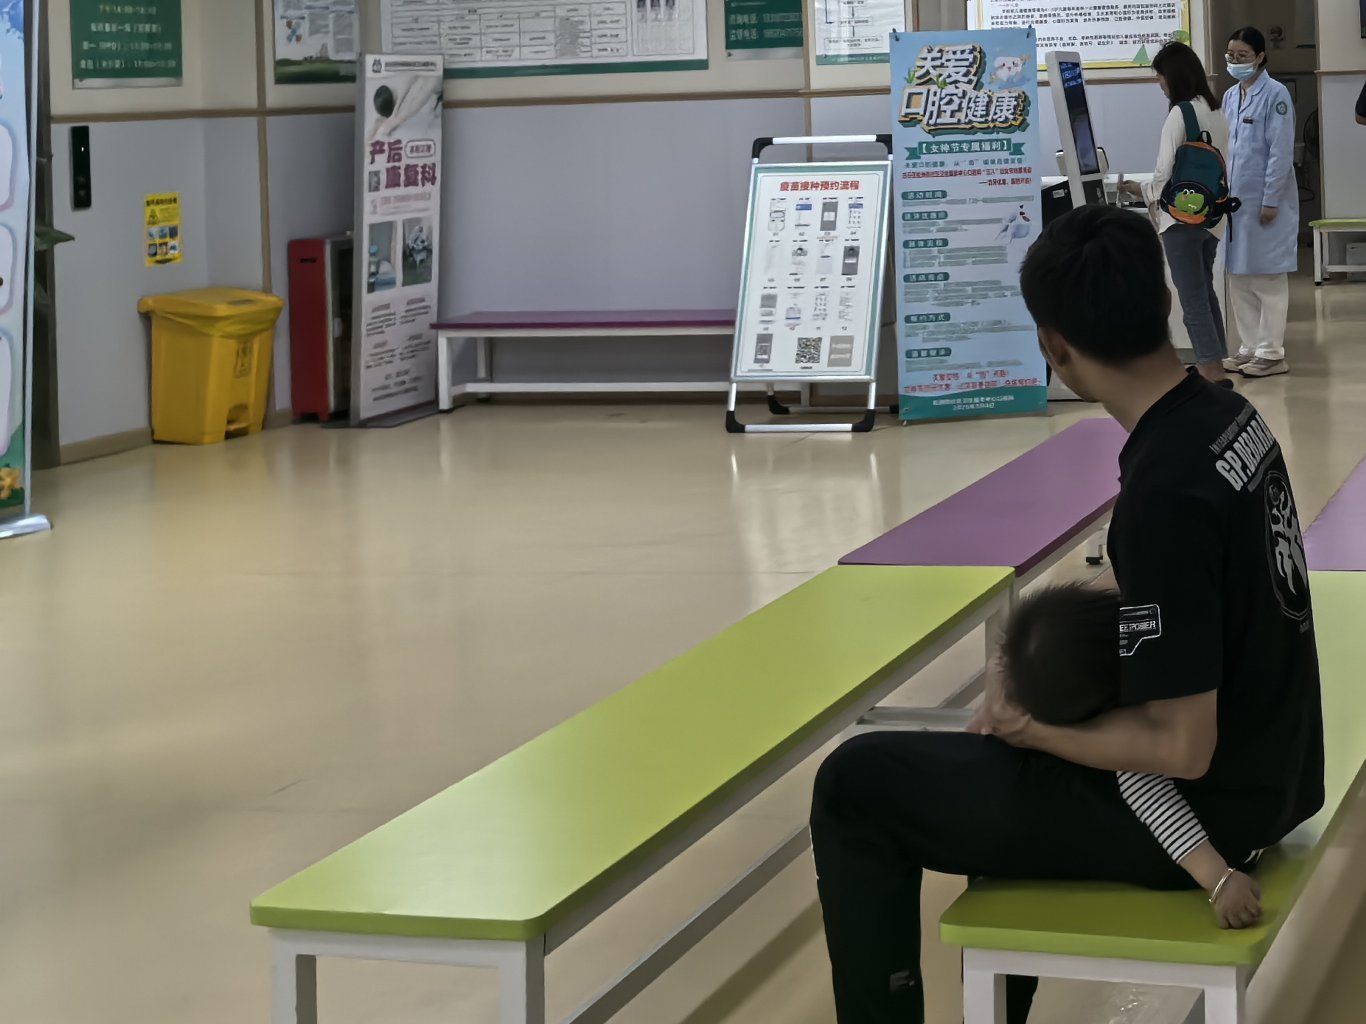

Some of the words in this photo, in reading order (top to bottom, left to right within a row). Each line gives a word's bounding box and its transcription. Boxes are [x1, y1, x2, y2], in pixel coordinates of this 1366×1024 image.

[915, 45, 978, 86] 关爱
[901, 86, 1019, 126] 口腔健康
[369, 139, 403, 164] 产后
[385, 163, 437, 188] 康复科
[779, 180, 860, 192] 疫苗接种预约流程
